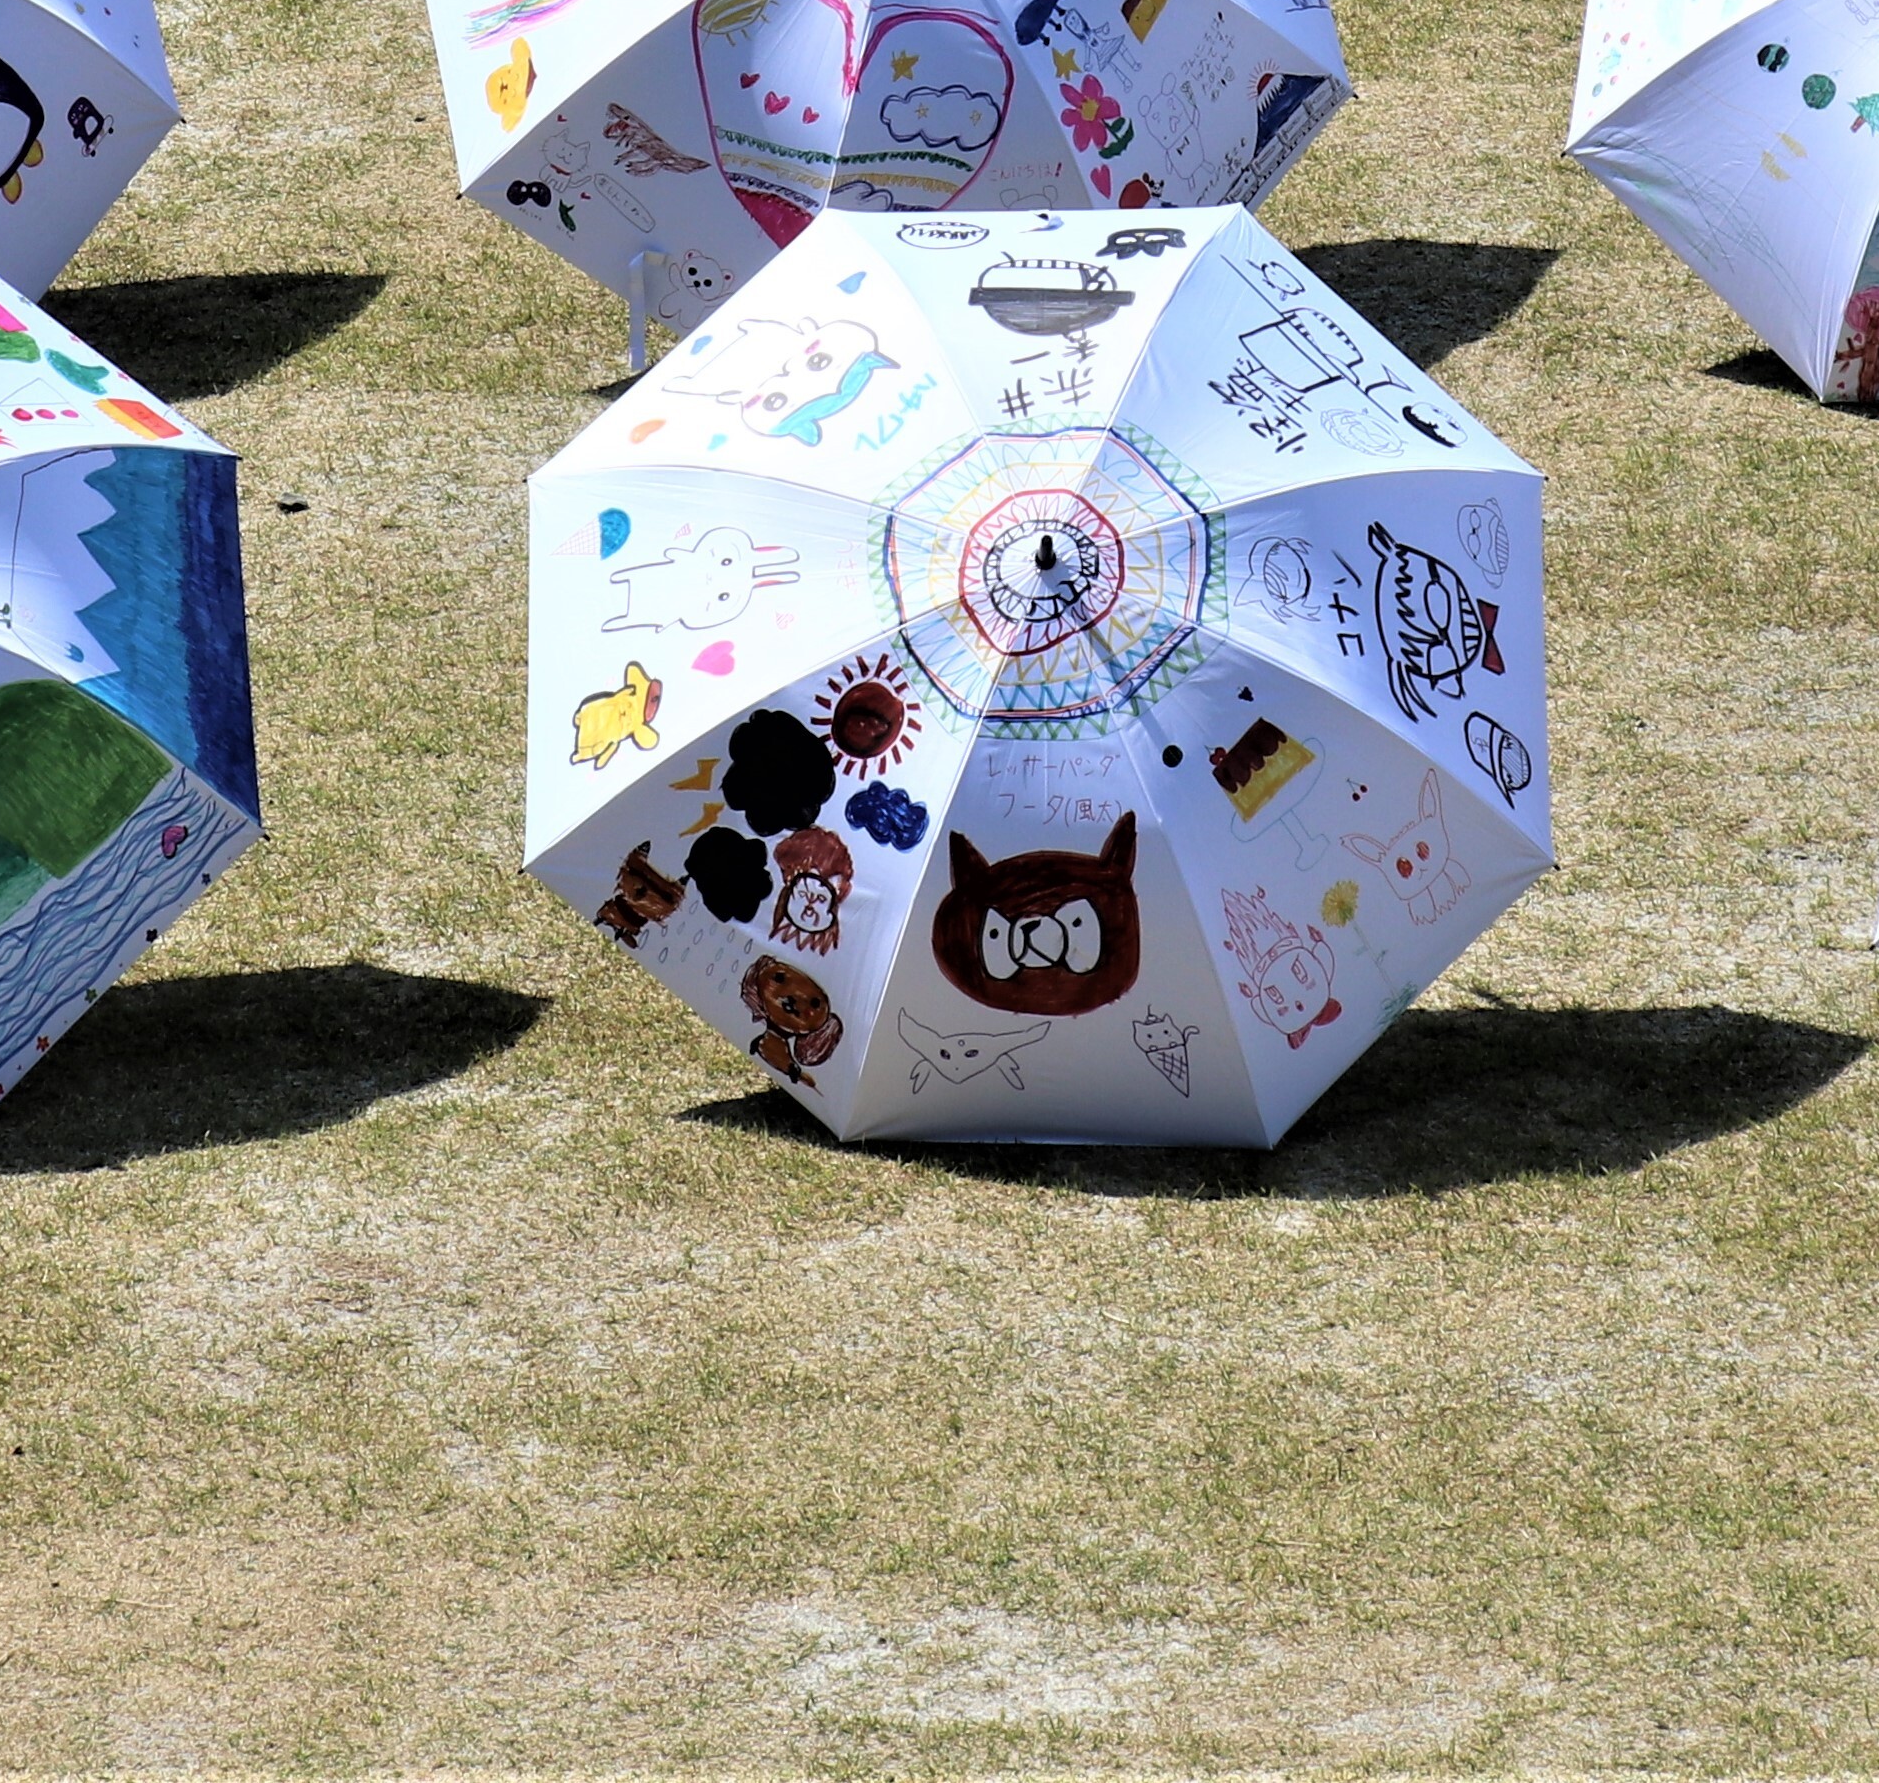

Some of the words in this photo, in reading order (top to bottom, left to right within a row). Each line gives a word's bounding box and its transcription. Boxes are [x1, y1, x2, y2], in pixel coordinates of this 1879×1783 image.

[1327, 548, 1364, 658] コナン
[987, 753, 1122, 791] レッサーパンダ
[997, 792, 1123, 830] フータ(風太)
